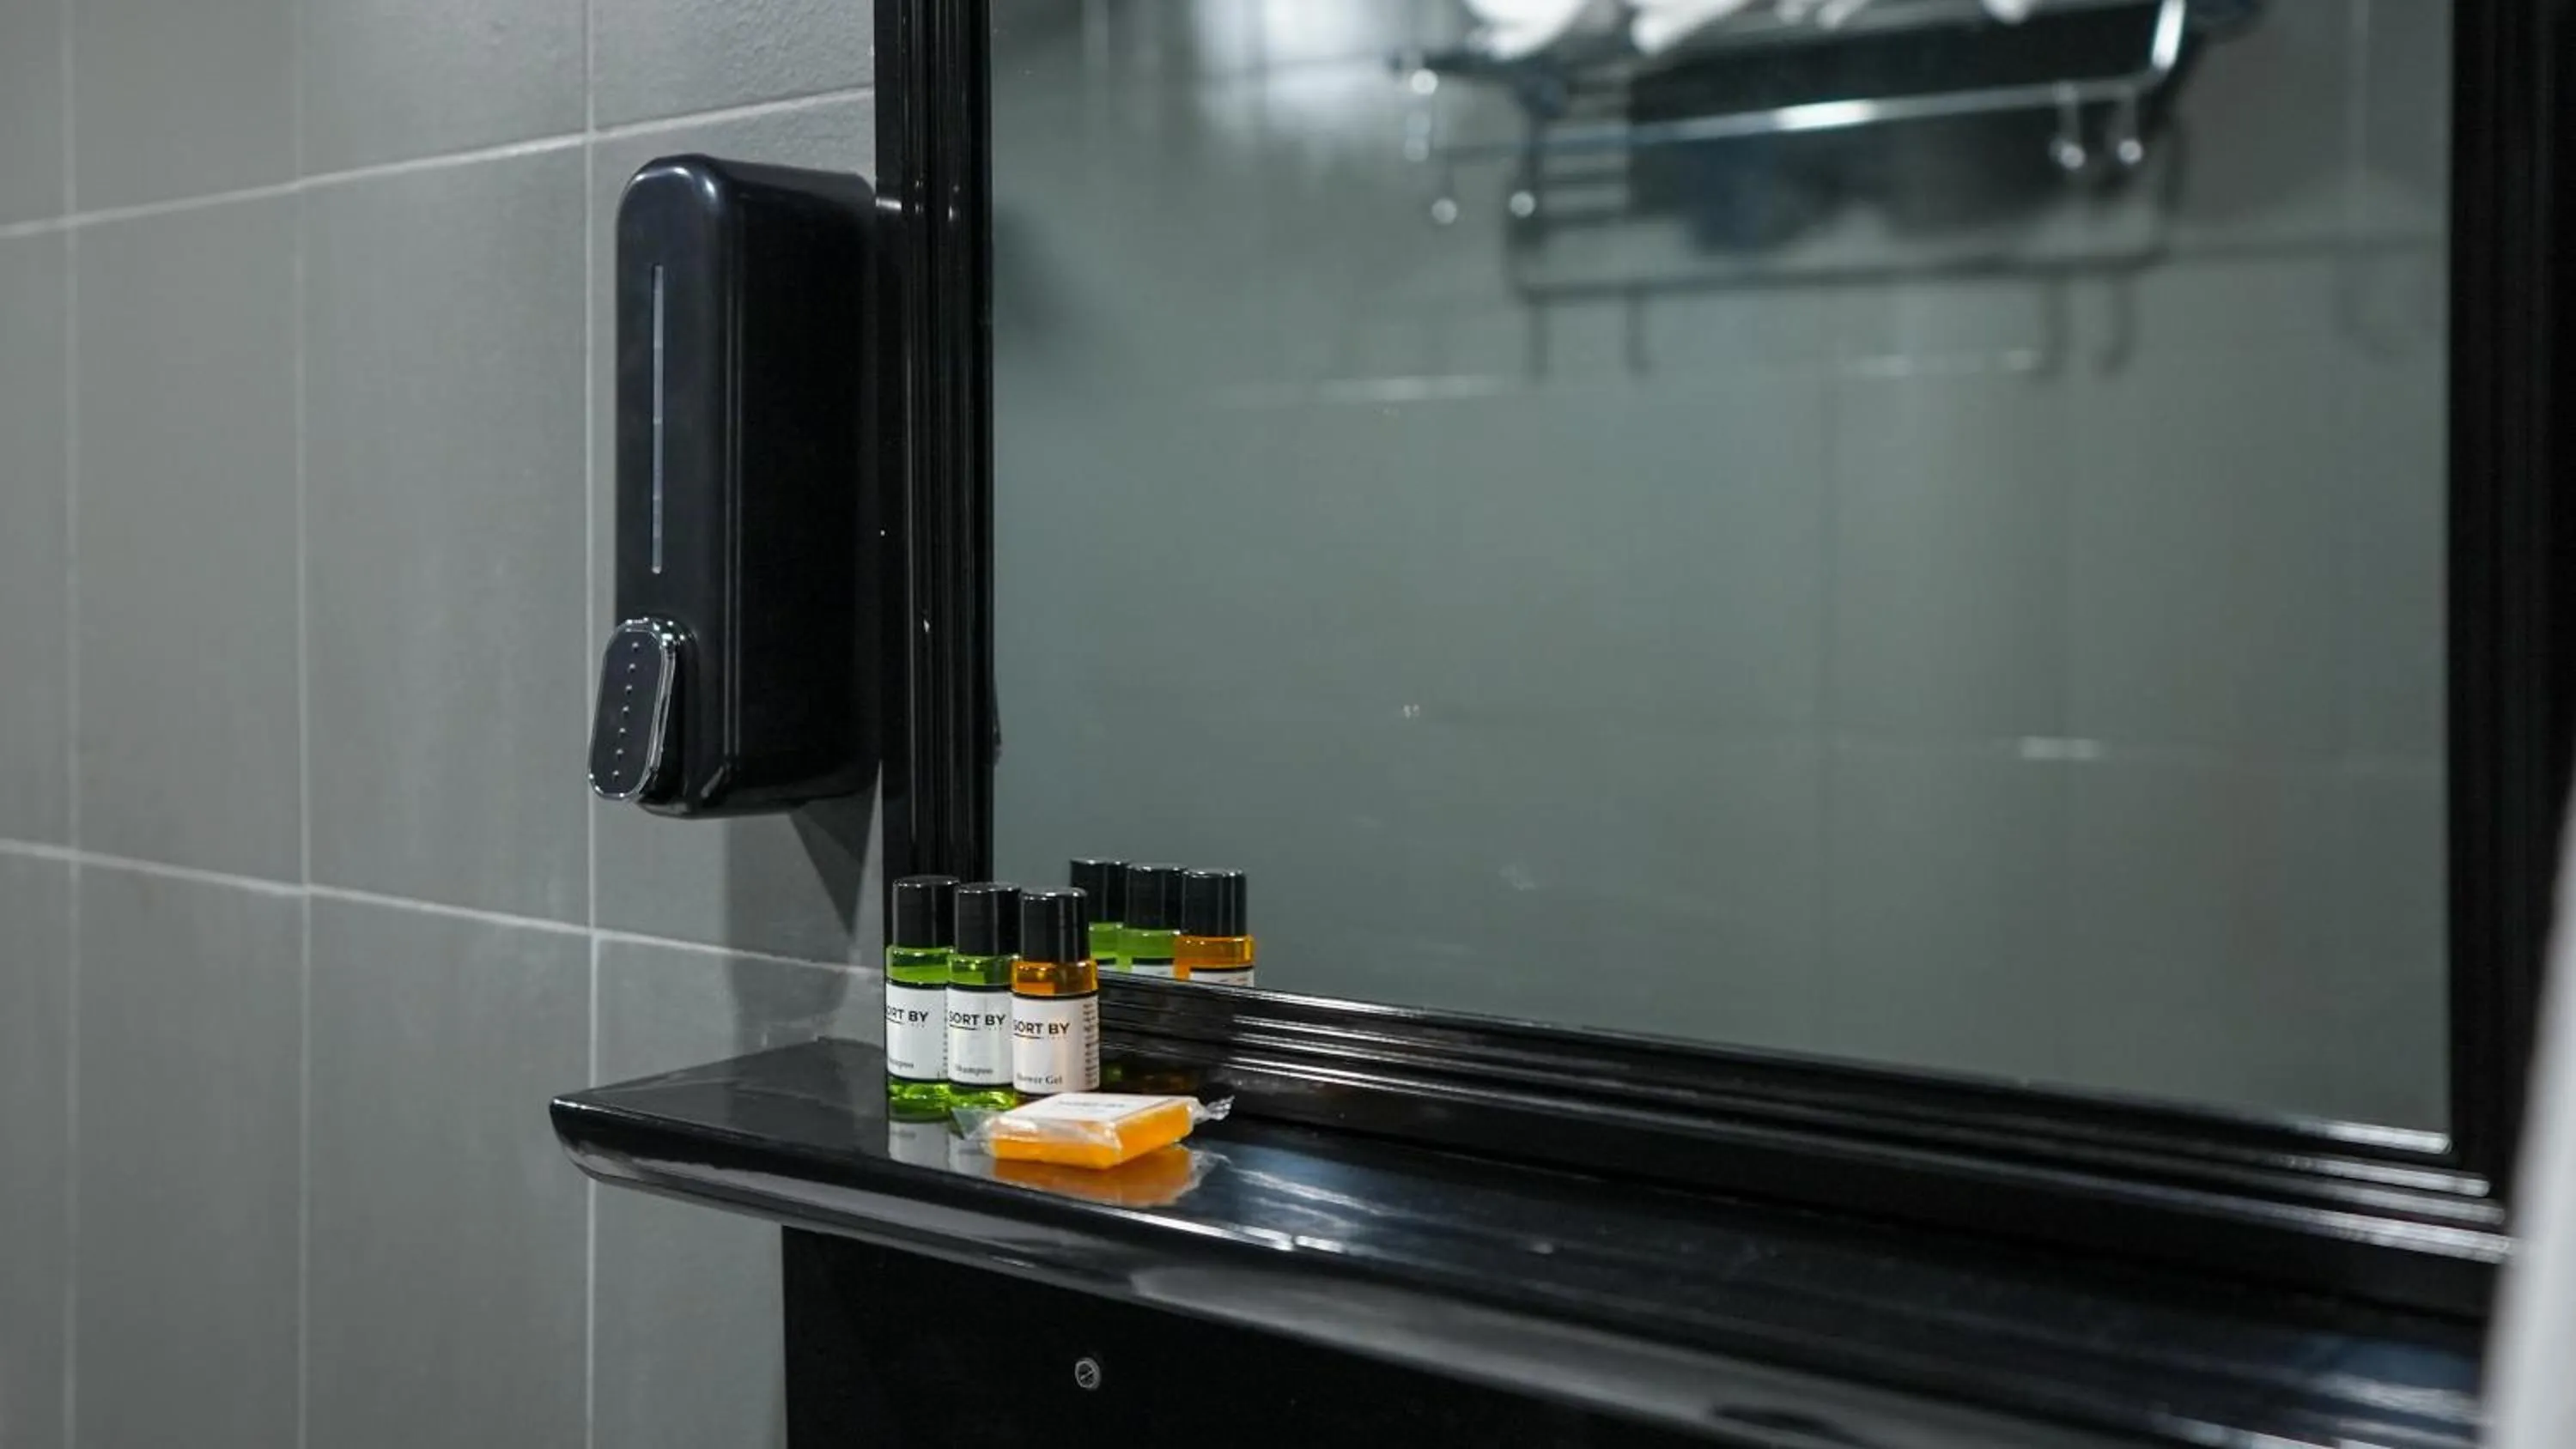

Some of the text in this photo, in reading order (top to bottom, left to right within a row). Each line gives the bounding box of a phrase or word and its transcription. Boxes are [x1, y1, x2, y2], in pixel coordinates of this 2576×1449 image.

[886, 1005, 929, 1022] ORT BY
[985, 1014, 1006, 1026] BY
[1048, 1022, 1071, 1034] BY
